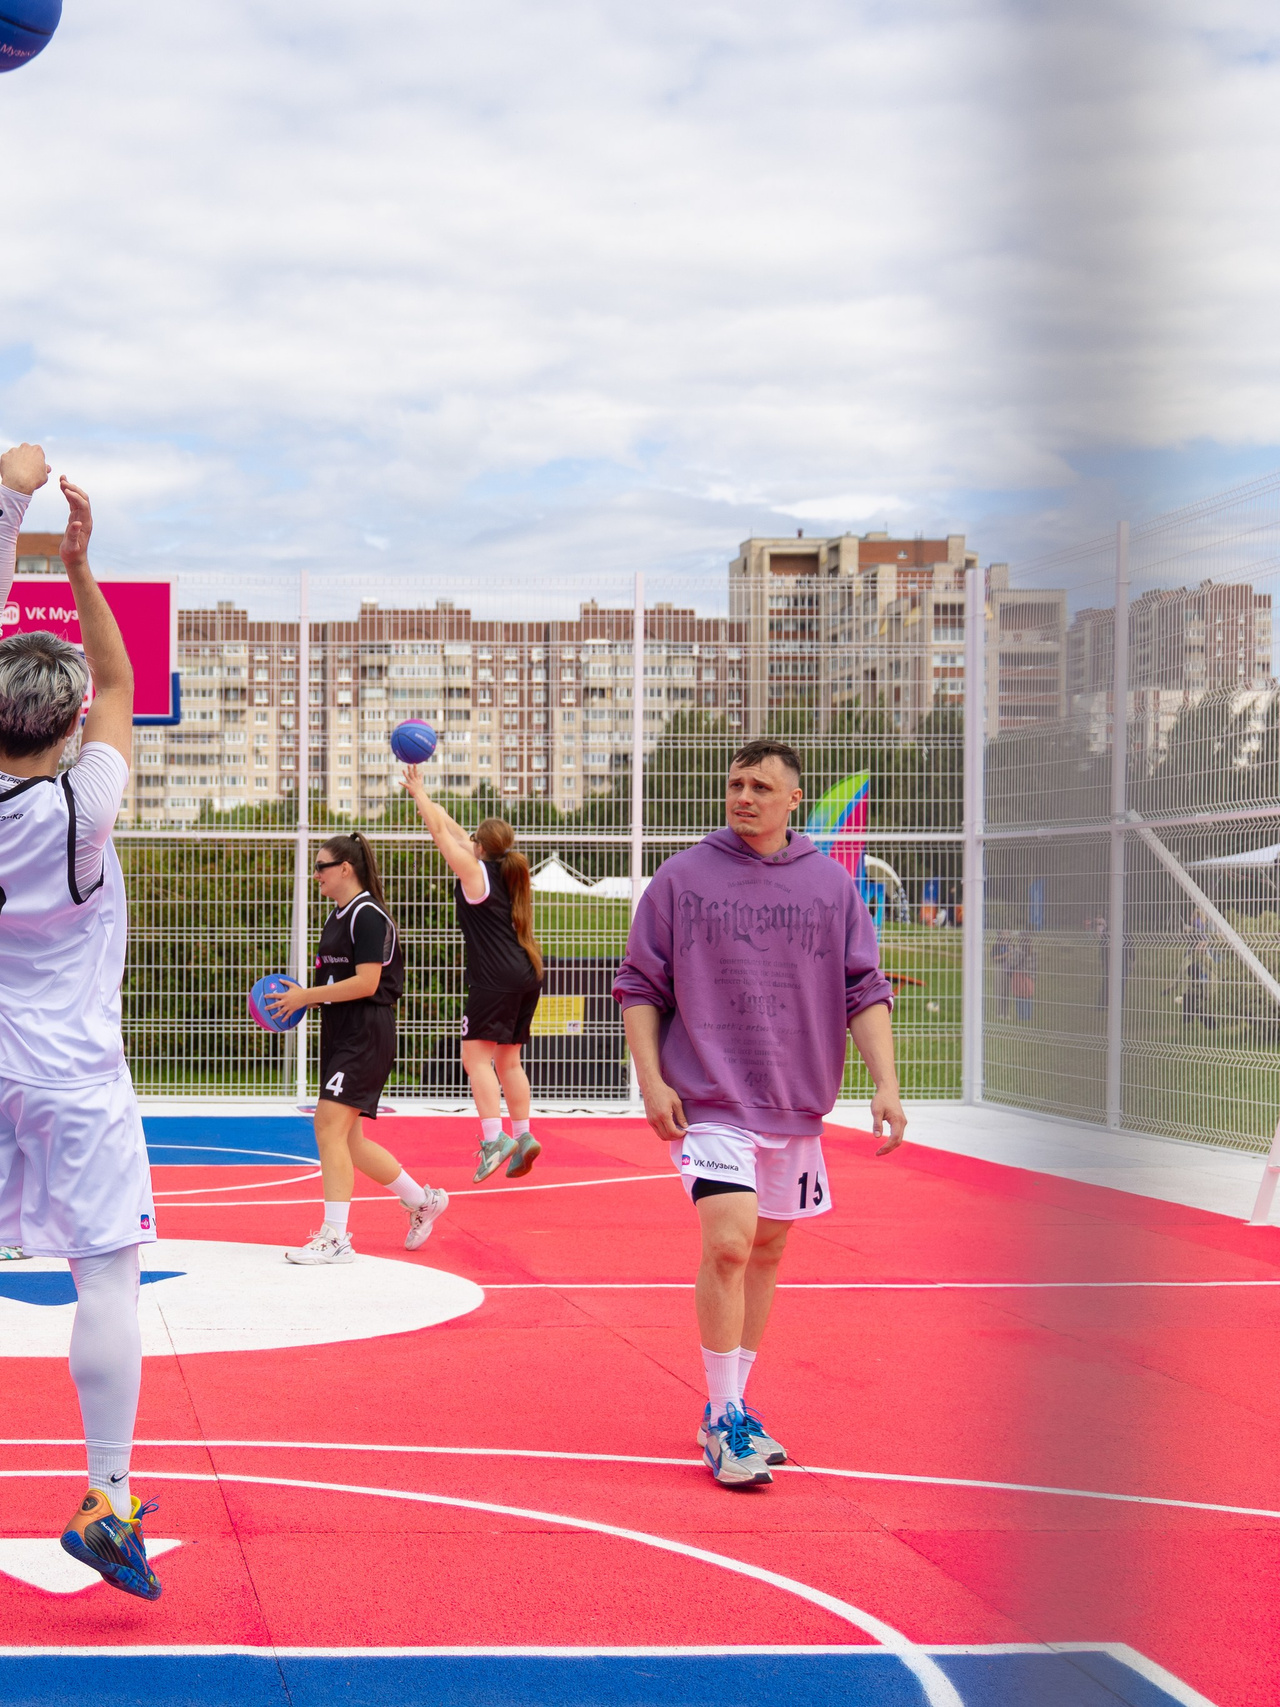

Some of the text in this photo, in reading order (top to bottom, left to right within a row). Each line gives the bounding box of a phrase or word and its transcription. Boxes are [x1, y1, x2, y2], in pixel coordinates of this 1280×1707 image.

[0, 43, 36, 57] Музык
[24, 606, 79, 624] VK Муз
[325, 1071, 345, 1097] 4
[693, 1158, 739, 1172] VK Музыка
